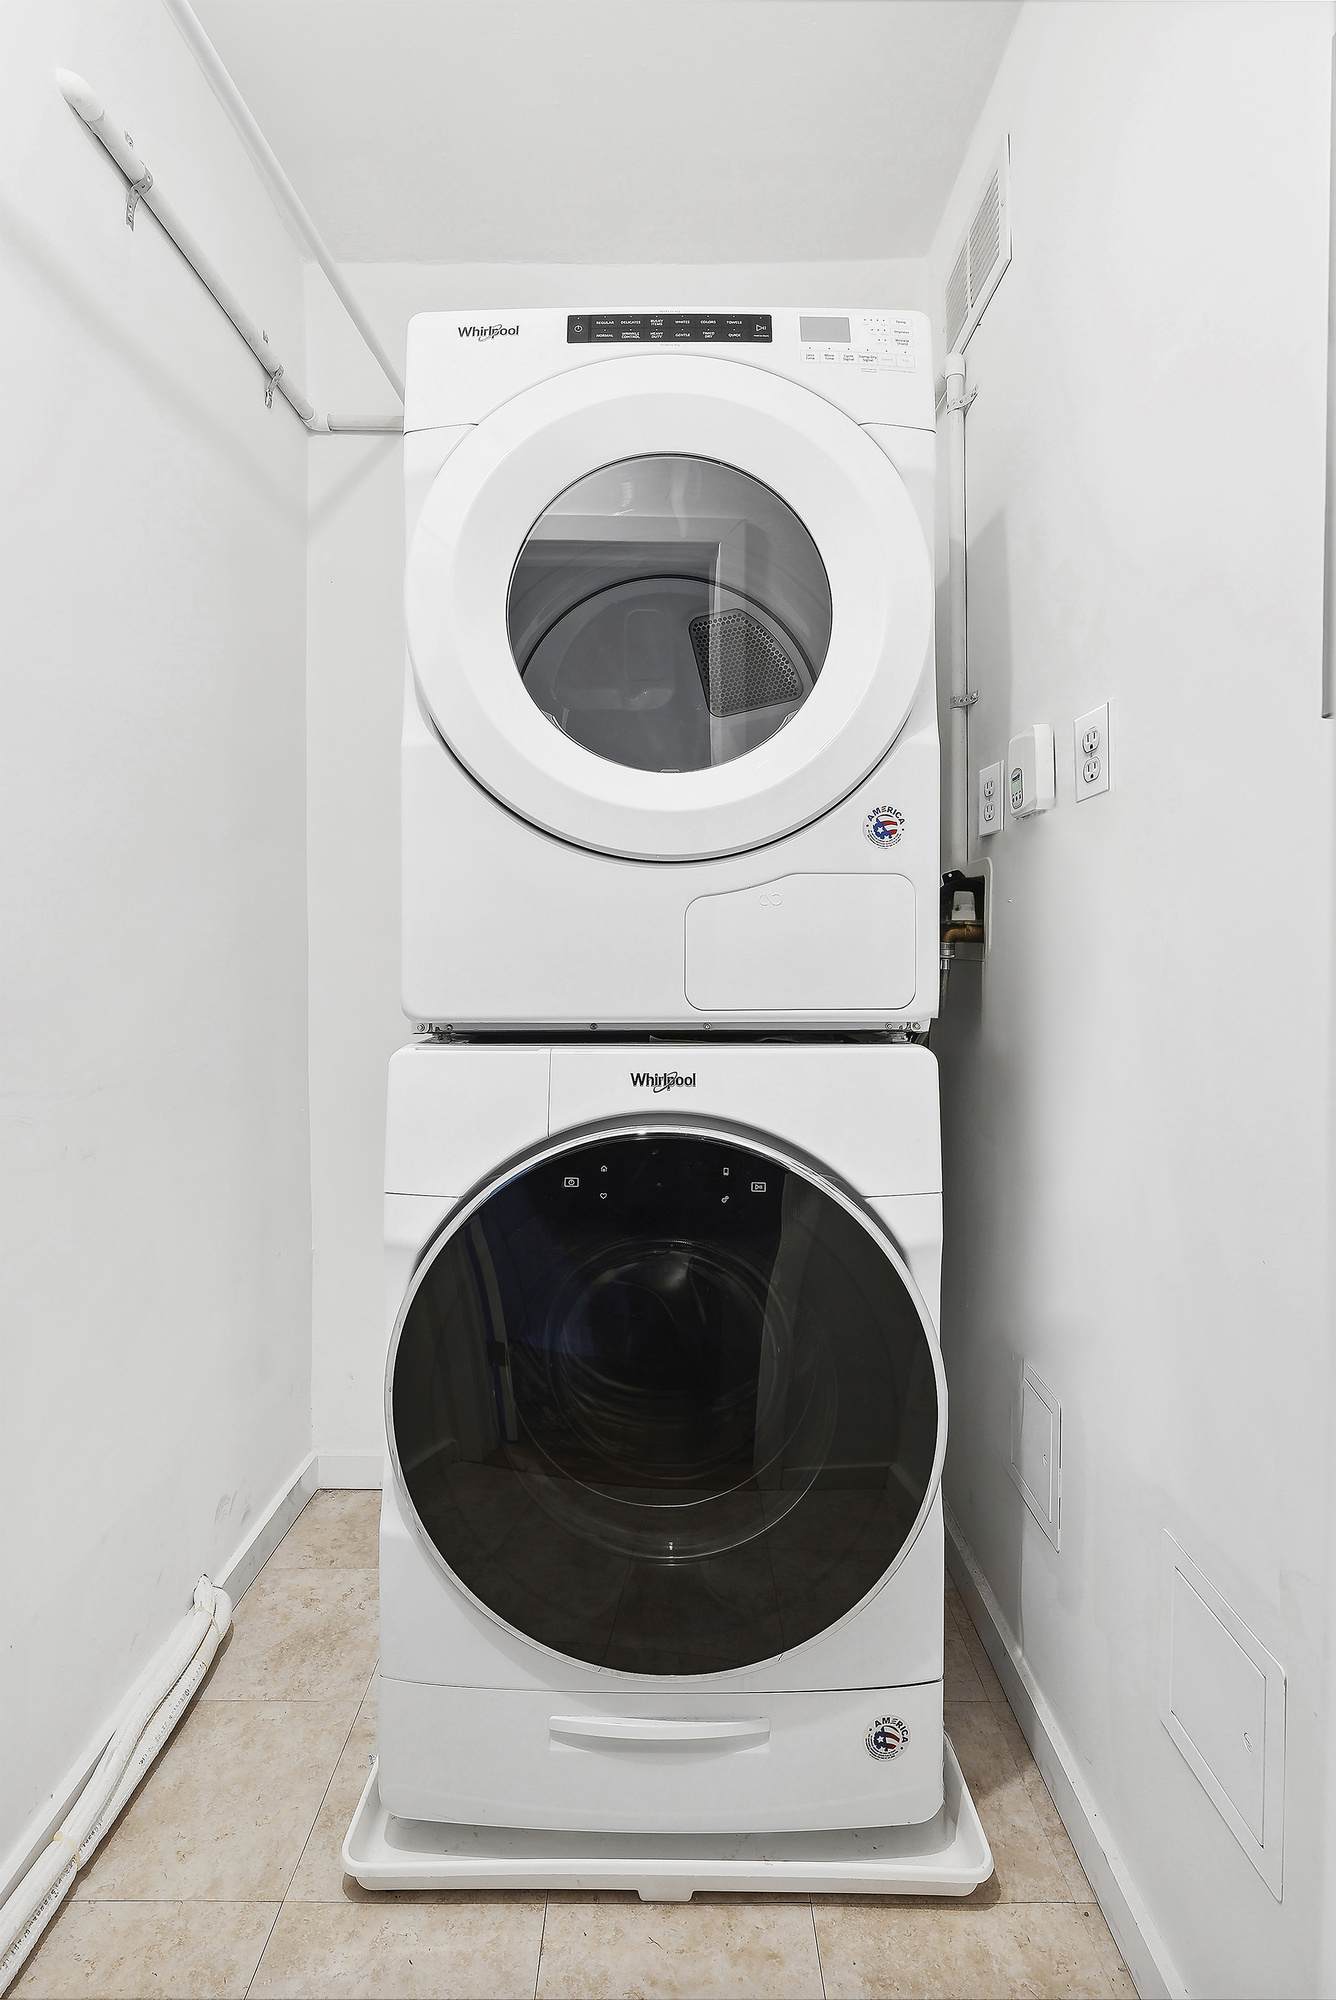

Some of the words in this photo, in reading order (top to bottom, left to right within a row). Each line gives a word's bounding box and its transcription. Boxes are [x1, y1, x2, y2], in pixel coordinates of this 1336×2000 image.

[458, 324, 519, 341] Whirlpool
[867, 805, 905, 825] AMERICA
[630, 1072, 696, 1092] Whirlpool
[874, 1716, 909, 1744] AMERICA
